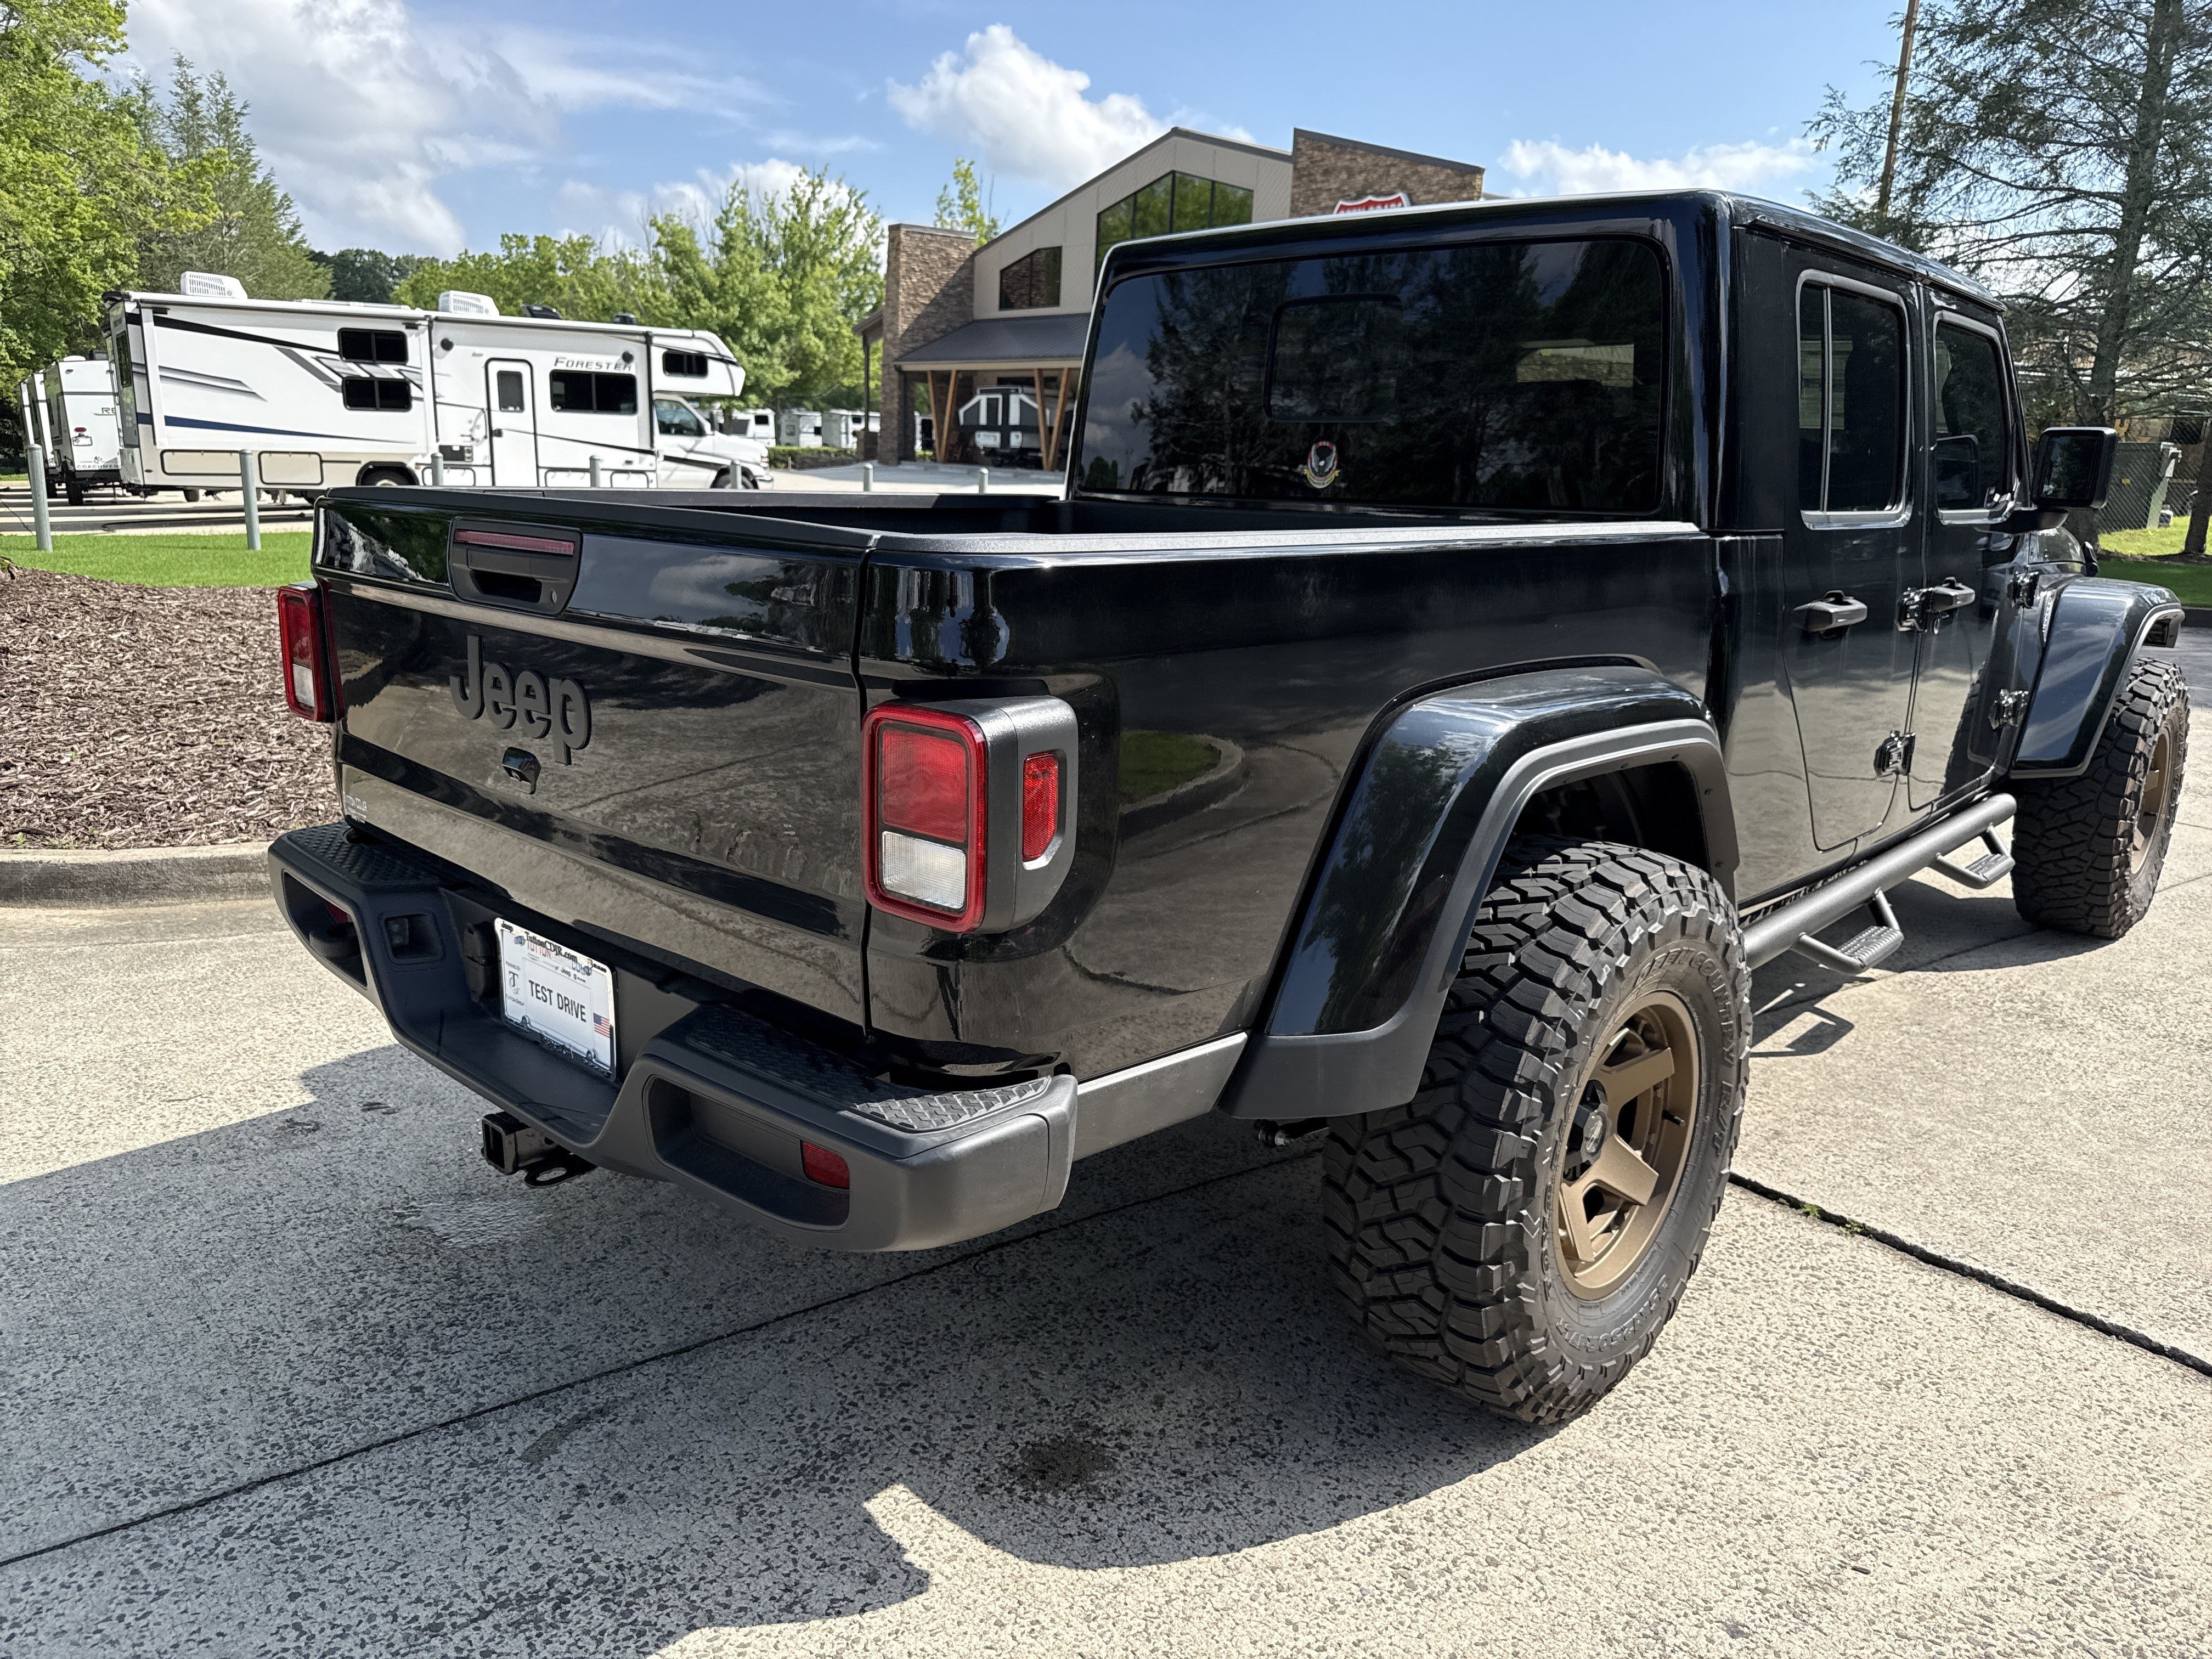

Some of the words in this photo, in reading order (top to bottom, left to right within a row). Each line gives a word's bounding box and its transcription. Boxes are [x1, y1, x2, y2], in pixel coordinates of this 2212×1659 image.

[450, 634, 592, 766] Jeep
[524, 931, 578, 963] TuttonCDJR.com
[528, 979, 554, 1006] TEST
[556, 992, 587, 1023] DRIVE
